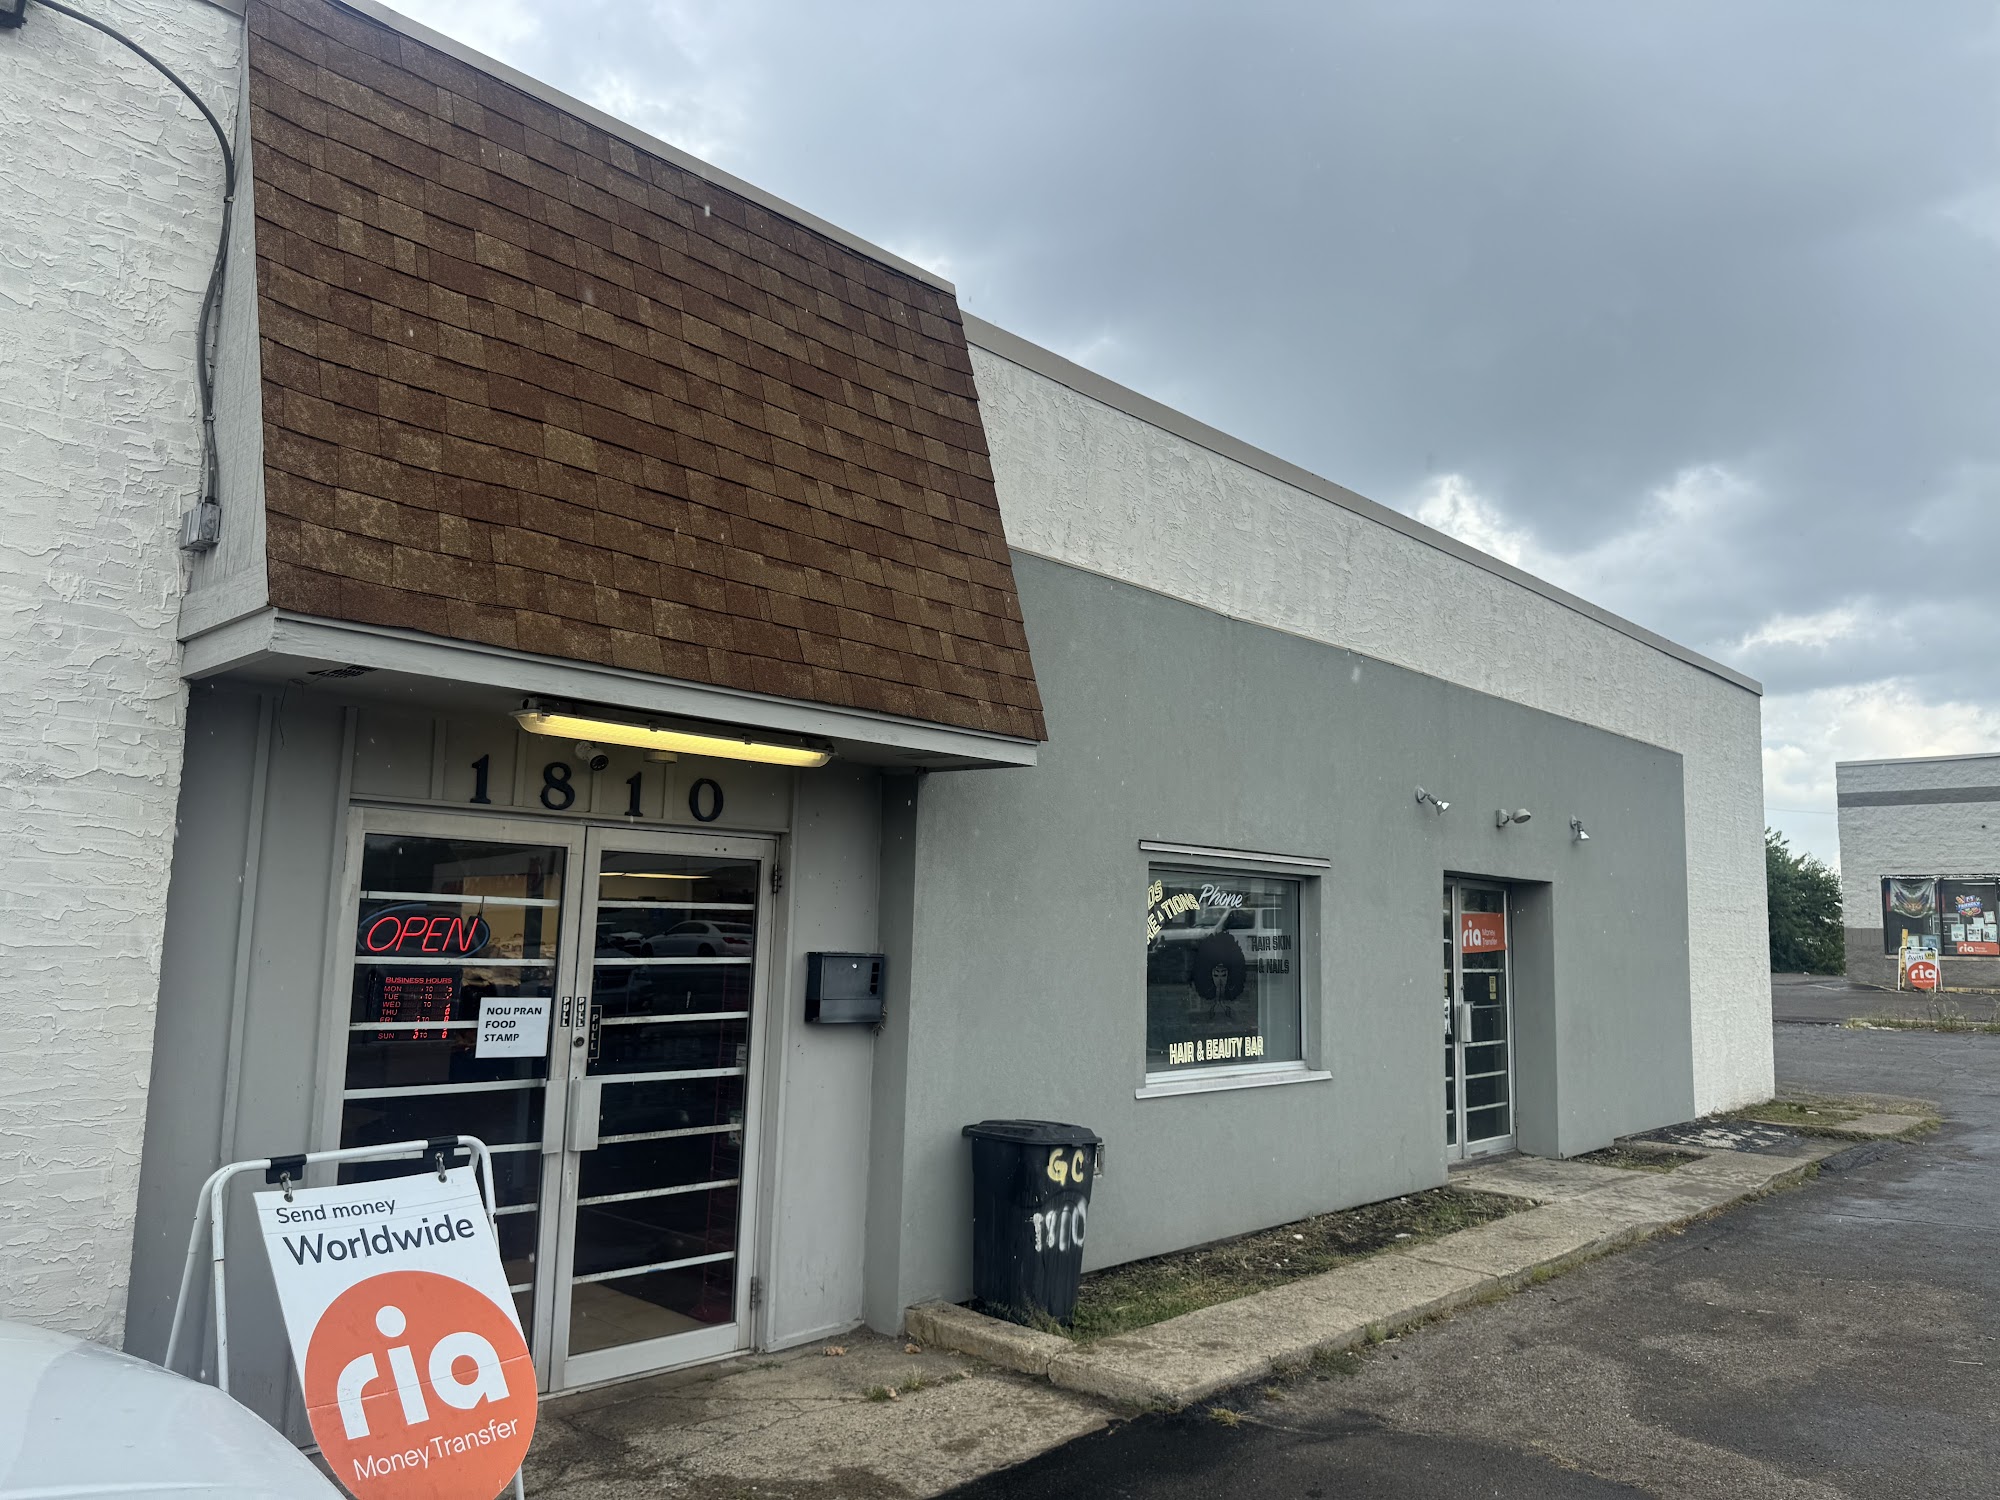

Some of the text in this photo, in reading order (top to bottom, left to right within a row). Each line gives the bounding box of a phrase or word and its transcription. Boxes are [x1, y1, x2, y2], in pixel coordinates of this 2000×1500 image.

[470, 754, 724, 822] 1810
[1199, 883, 1243, 908] Phone
[367, 916, 479, 952] OPEN
[1252, 935, 1291, 951] HAIR SKIN
[1463, 920, 1482, 947] ria
[1959, 944, 1975, 953] ria
[1259, 958, 1289, 974] & NAILS
[1911, 965, 1936, 979] ria
[485, 1020, 516, 1029] FOOD
[486, 1007, 542, 1015] NOU PRAN
[562, 997, 570, 1027] PULL
[377, 1032, 395, 1040] SUN
[484, 1033, 520, 1042] STAMP
[590, 1014, 599, 1050] PULL
[1169, 1036, 1264, 1065] HAIR & BEAUTY BAR
[1047, 1148, 1084, 1186] GC
[276, 1199, 397, 1224] Send money
[1033, 1198, 1087, 1252] 1810
[282, 1213, 475, 1266] Worldwide
[336, 1305, 511, 1440] ria
[352, 1417, 519, 1481] Money Transfer
